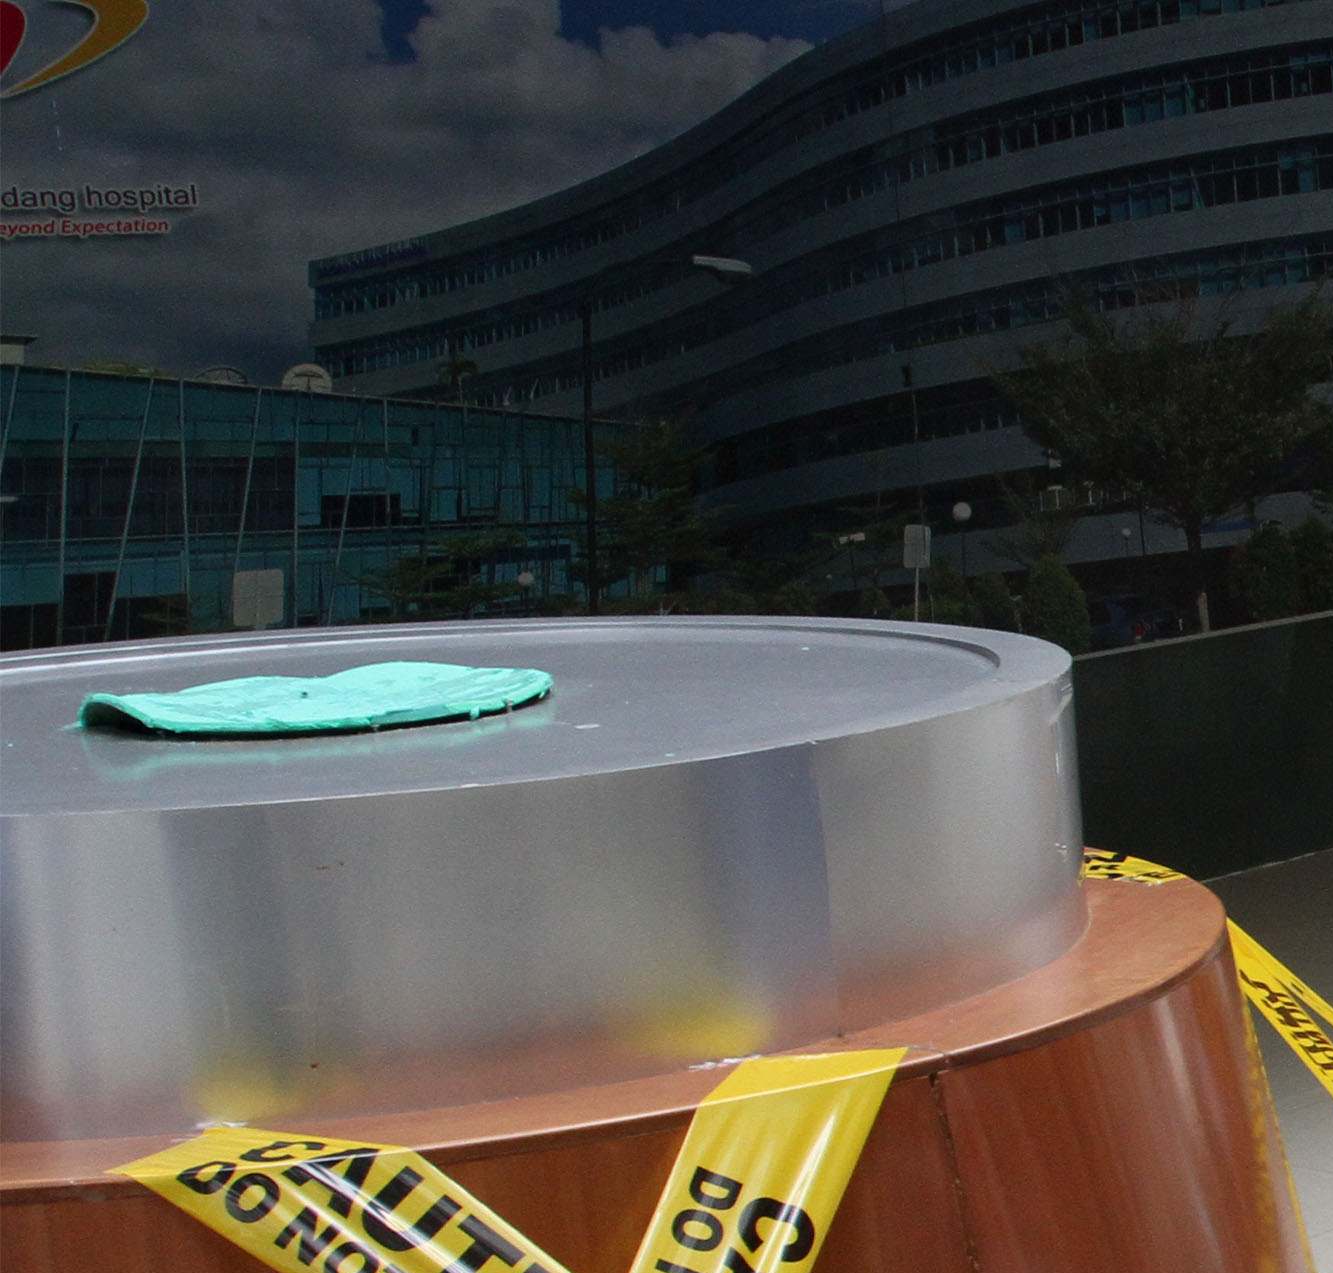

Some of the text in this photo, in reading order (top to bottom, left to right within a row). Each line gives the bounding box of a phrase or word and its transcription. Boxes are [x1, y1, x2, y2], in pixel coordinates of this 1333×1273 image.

[85, 185, 197, 210] hospital
[61, 219, 169, 235] Expectation
[176, 1159, 280, 1224] DO
[672, 1166, 743, 1252] DO
